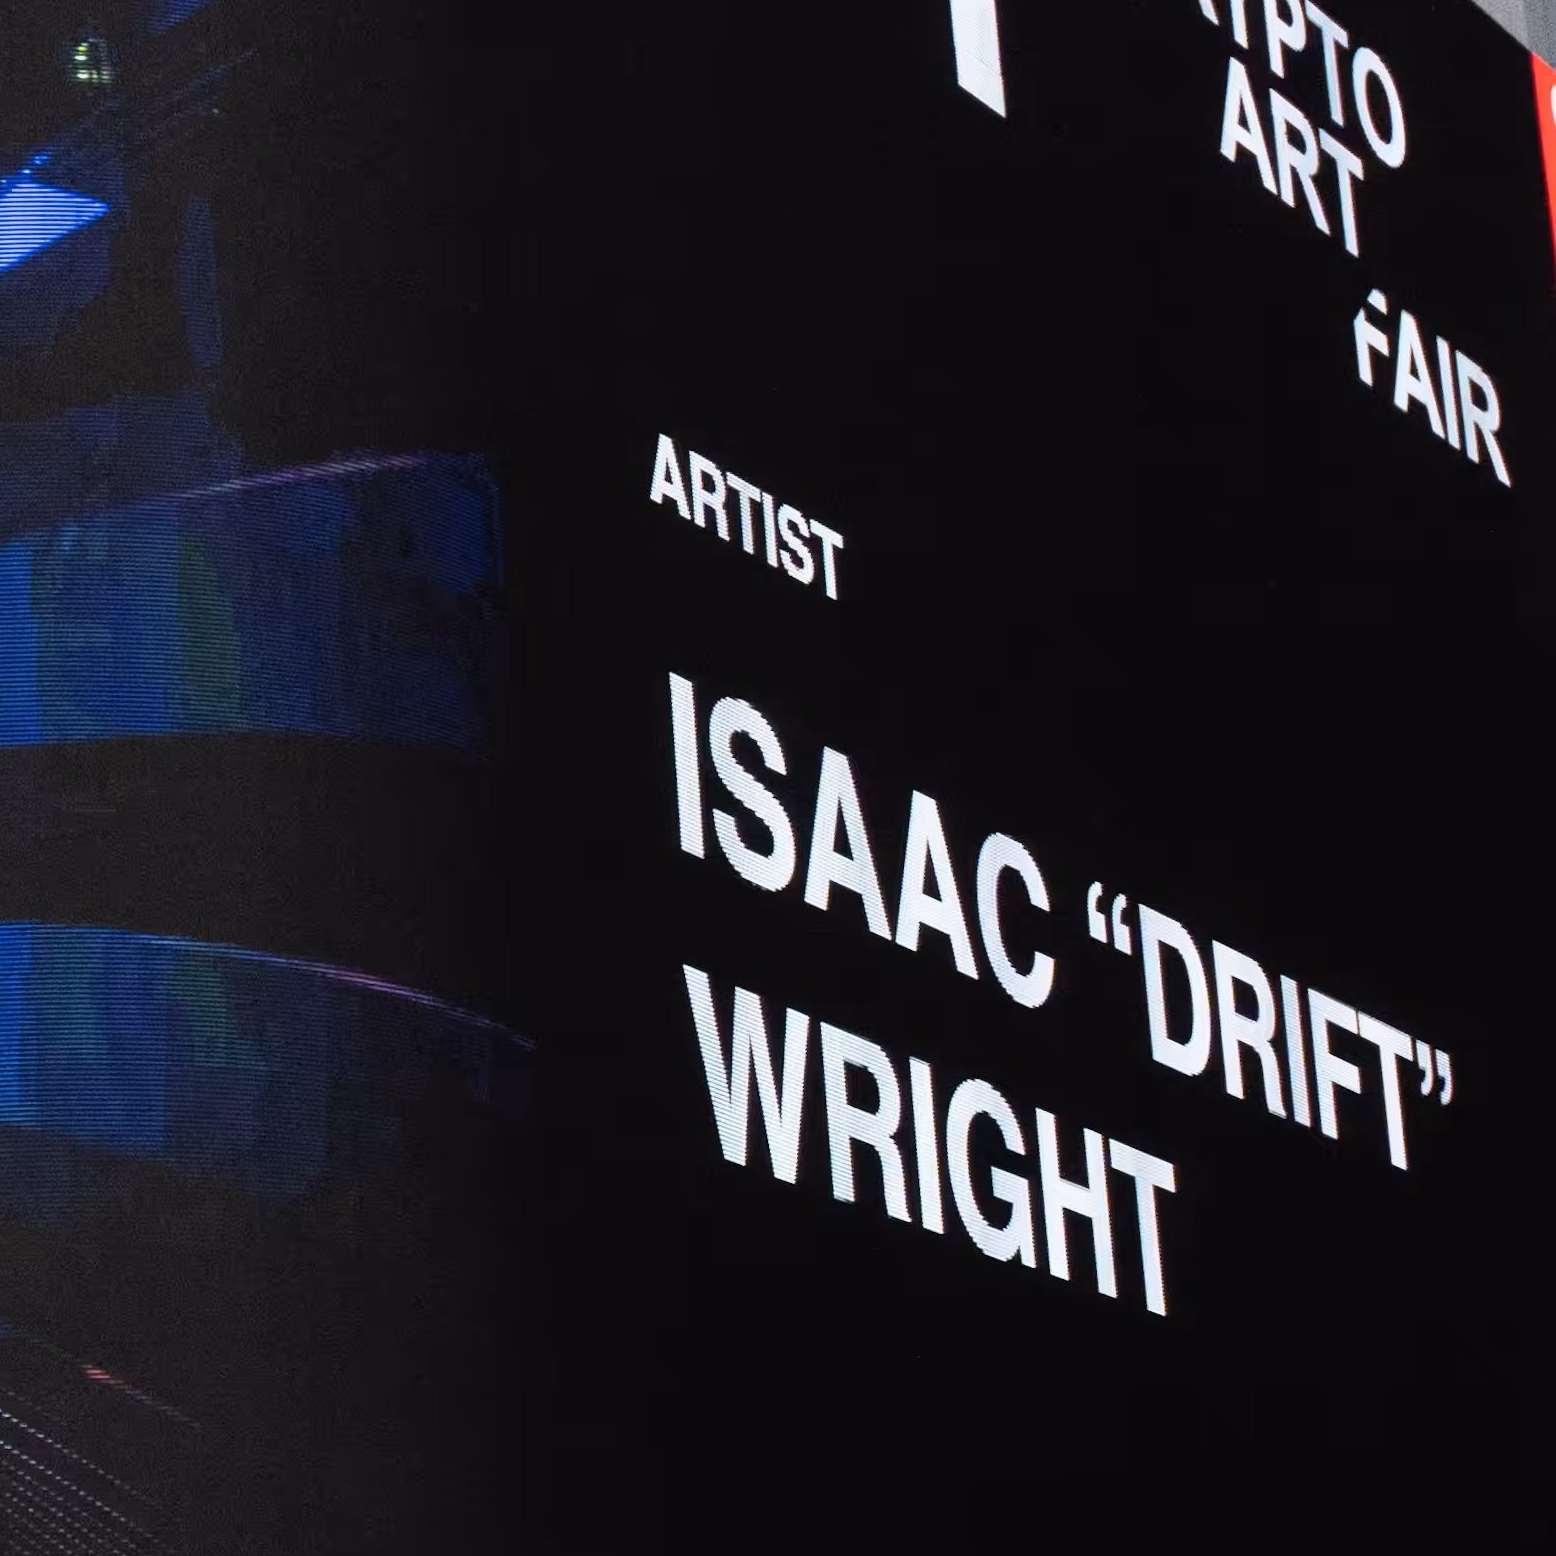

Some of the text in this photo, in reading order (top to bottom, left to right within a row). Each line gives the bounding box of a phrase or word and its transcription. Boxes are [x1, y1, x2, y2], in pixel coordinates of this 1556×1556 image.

[1220, 57, 1363, 257] ART
[1354, 290, 1510, 487] FAIR
[650, 434, 843, 600] ARTIST
[669, 672, 1452, 1170] ISAAC “DRIFT”
[683, 964, 1176, 1316] WRIGHT
